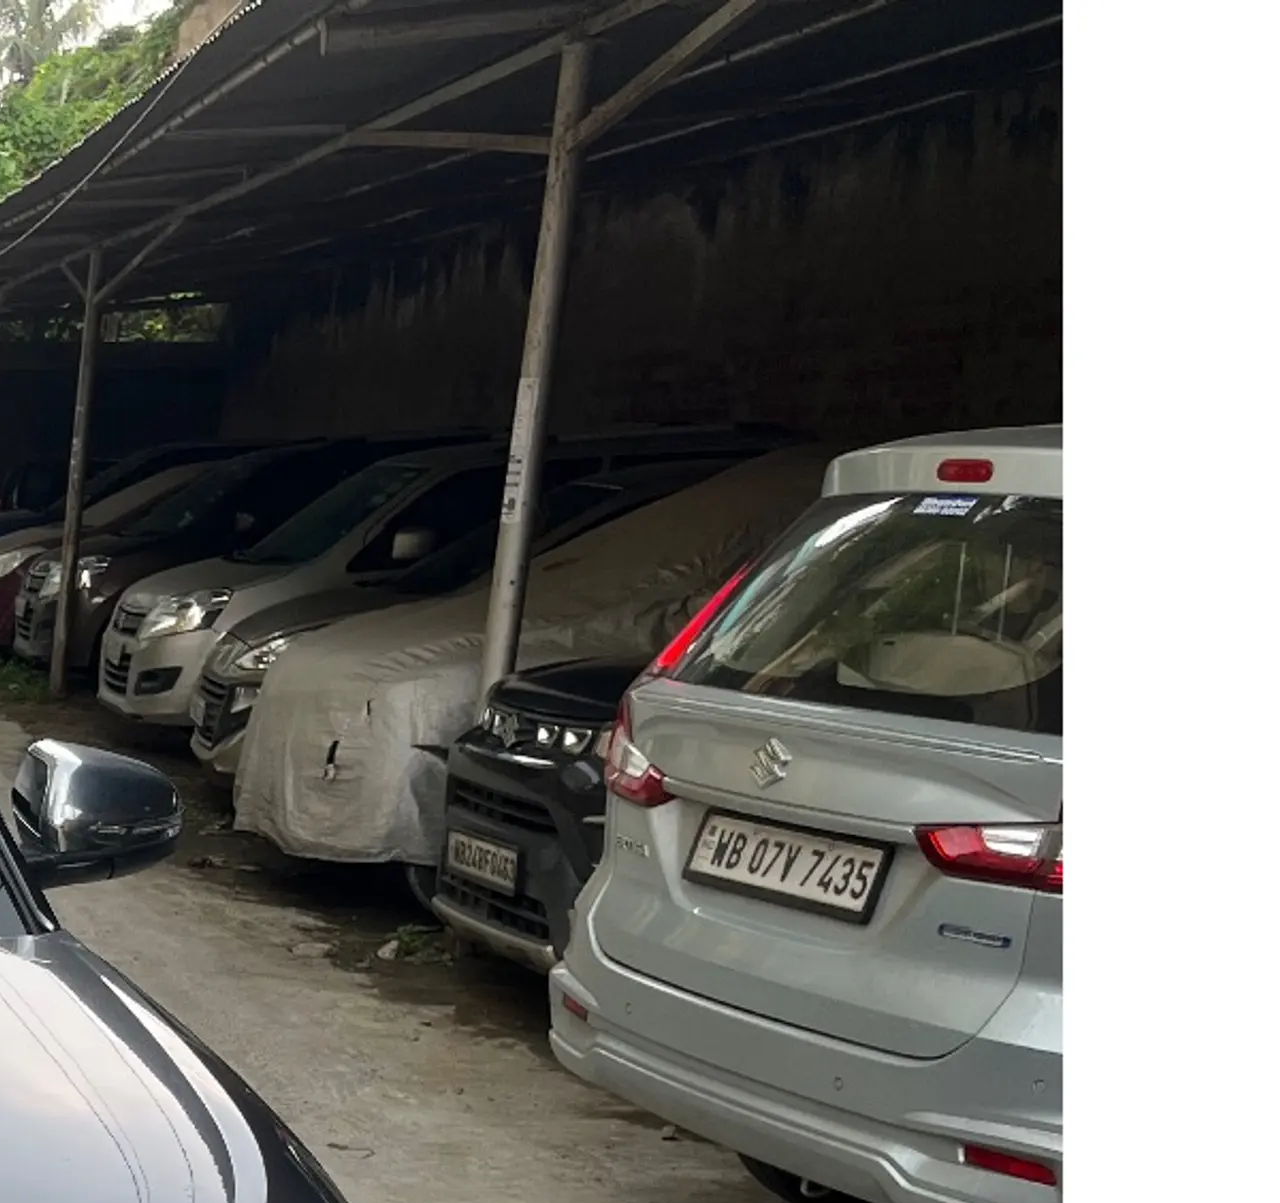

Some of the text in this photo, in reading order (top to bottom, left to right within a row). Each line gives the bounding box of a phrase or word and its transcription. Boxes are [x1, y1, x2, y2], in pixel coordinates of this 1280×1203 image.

[710, 827, 875, 900] WB 07V 7435
